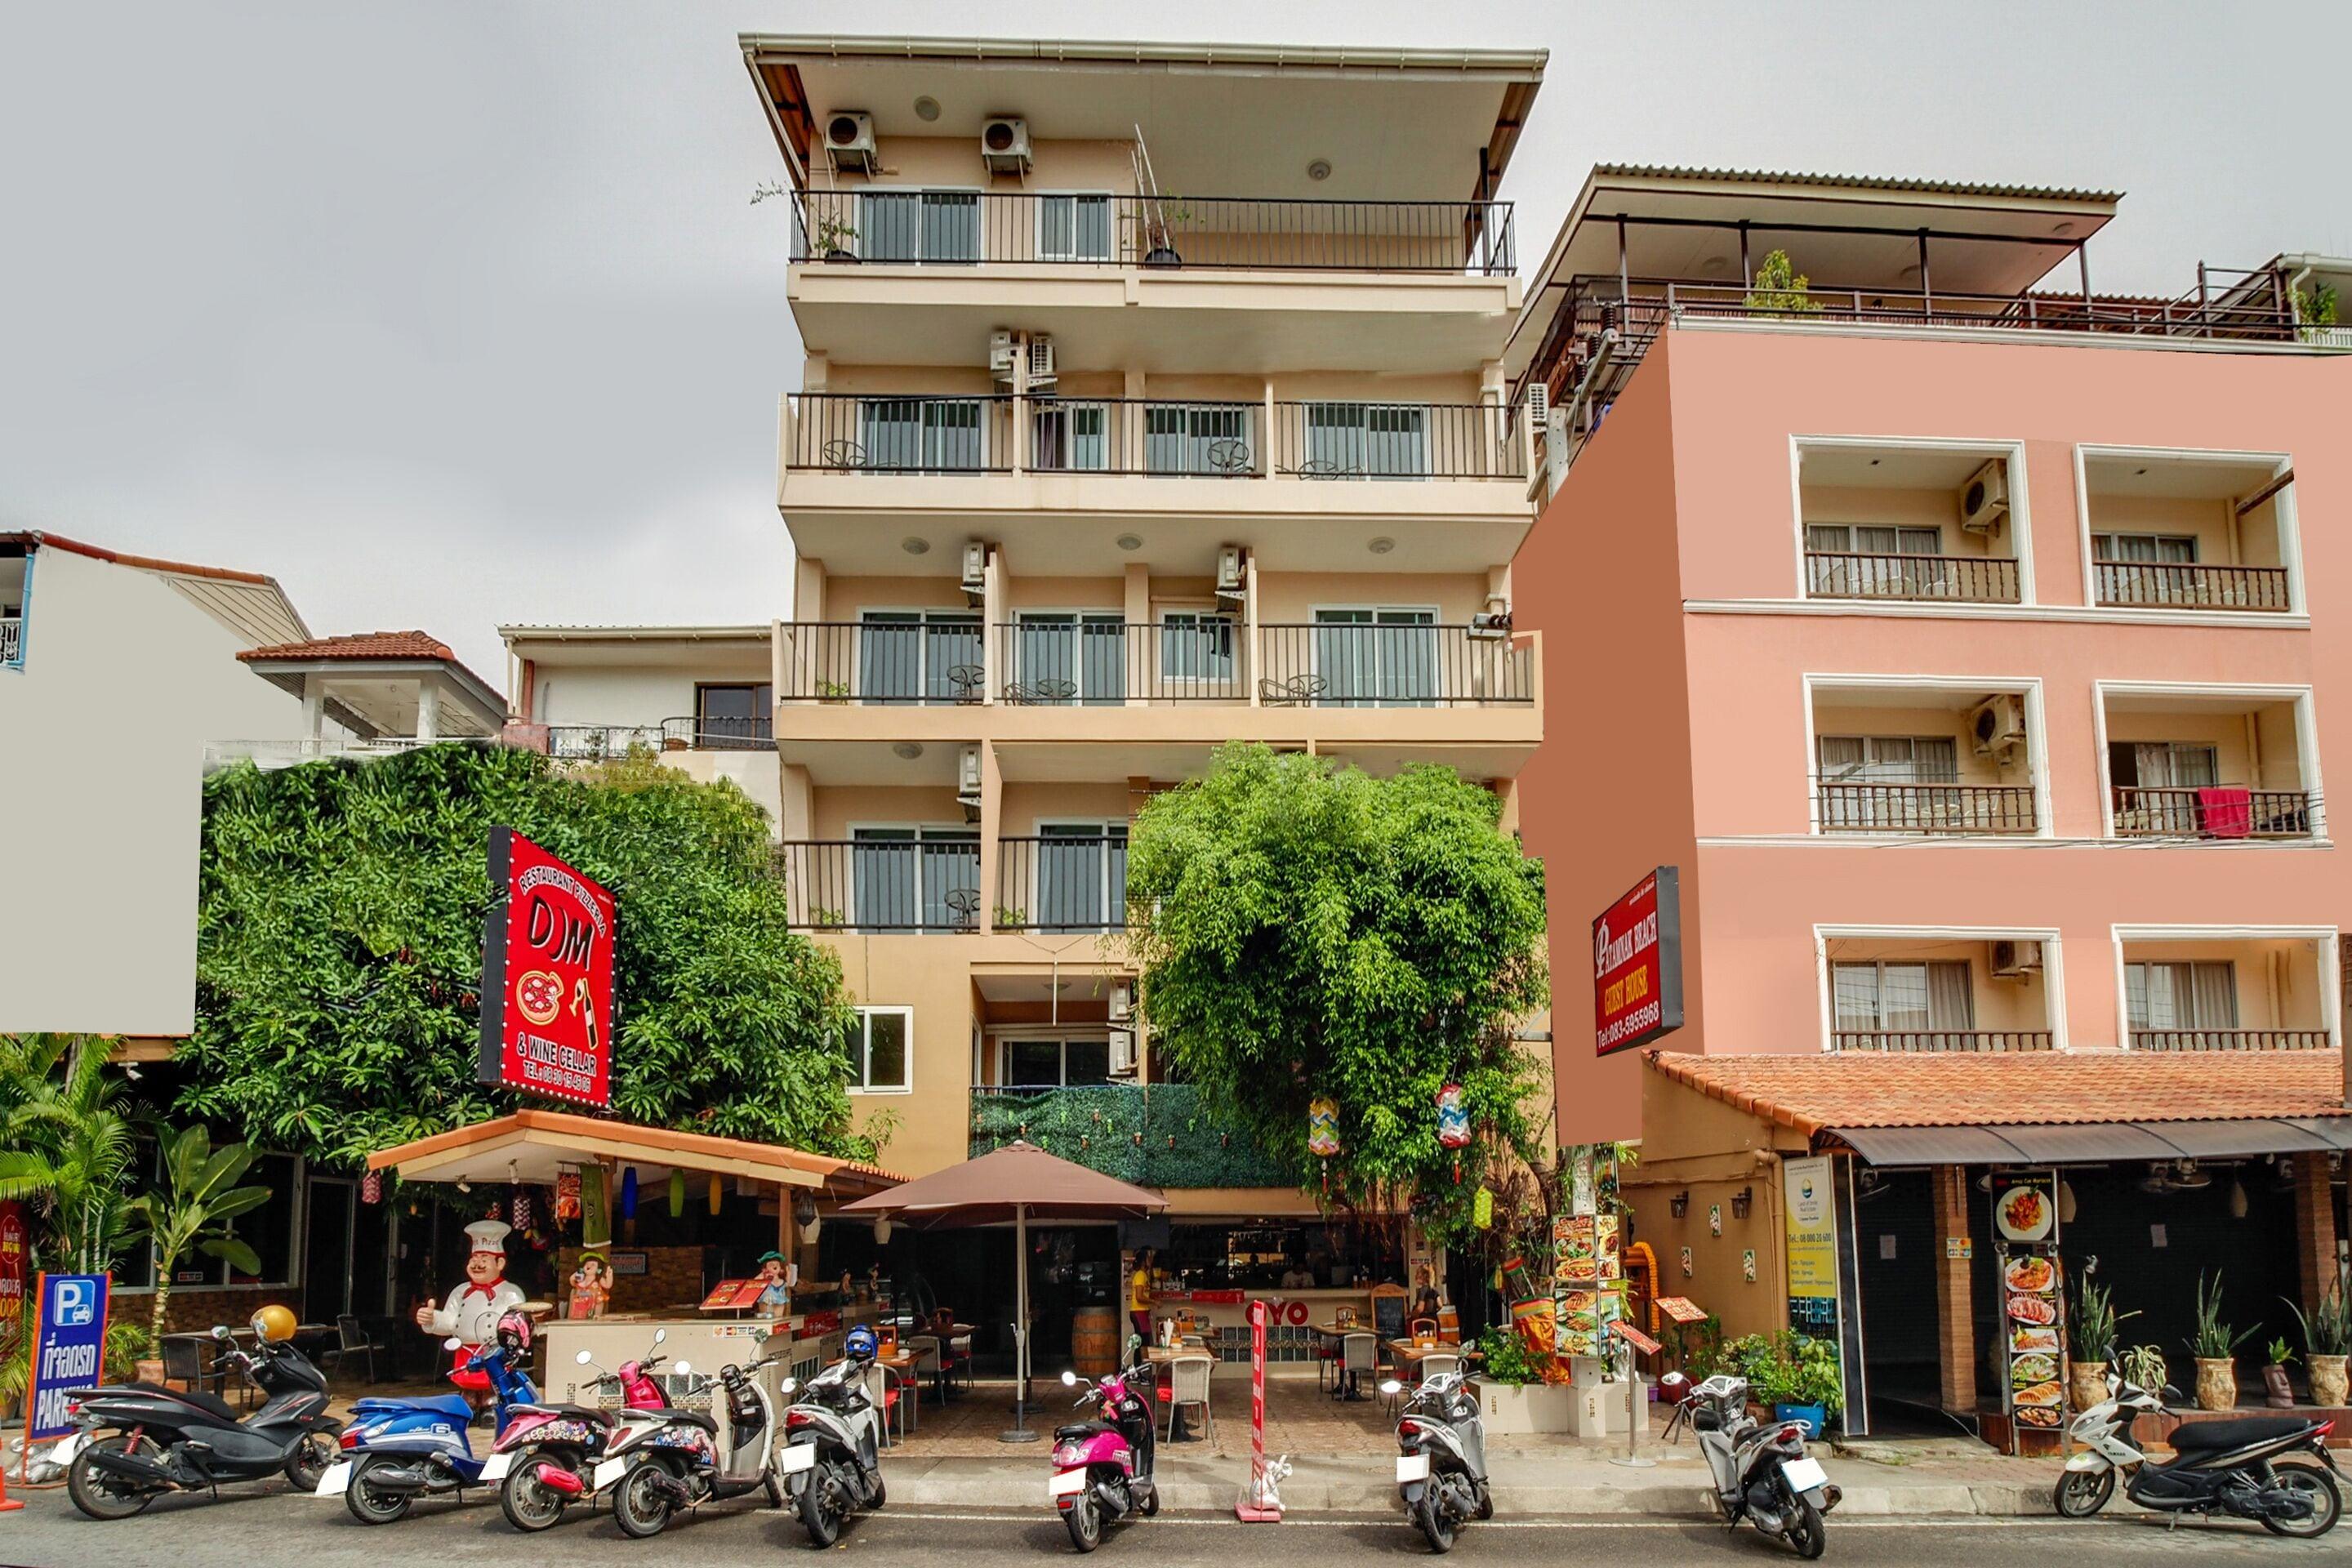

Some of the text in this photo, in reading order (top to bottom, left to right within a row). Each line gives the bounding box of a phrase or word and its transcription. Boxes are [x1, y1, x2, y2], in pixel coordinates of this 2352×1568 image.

[519, 866, 606, 938] RESTAURANT PIZZERIA
[528, 895, 595, 971] DJM
[1633, 911, 1657, 954] BEACH
[1605, 964, 1648, 1017] GUEST HOUSE
[1597, 1000, 1659, 1049] Tel:083-5955968
[517, 1031, 597, 1076] & WINE CELLAR
[57, 1283, 82, 1324] P
[42, 1332, 96, 1380] ที่จอดรถ
